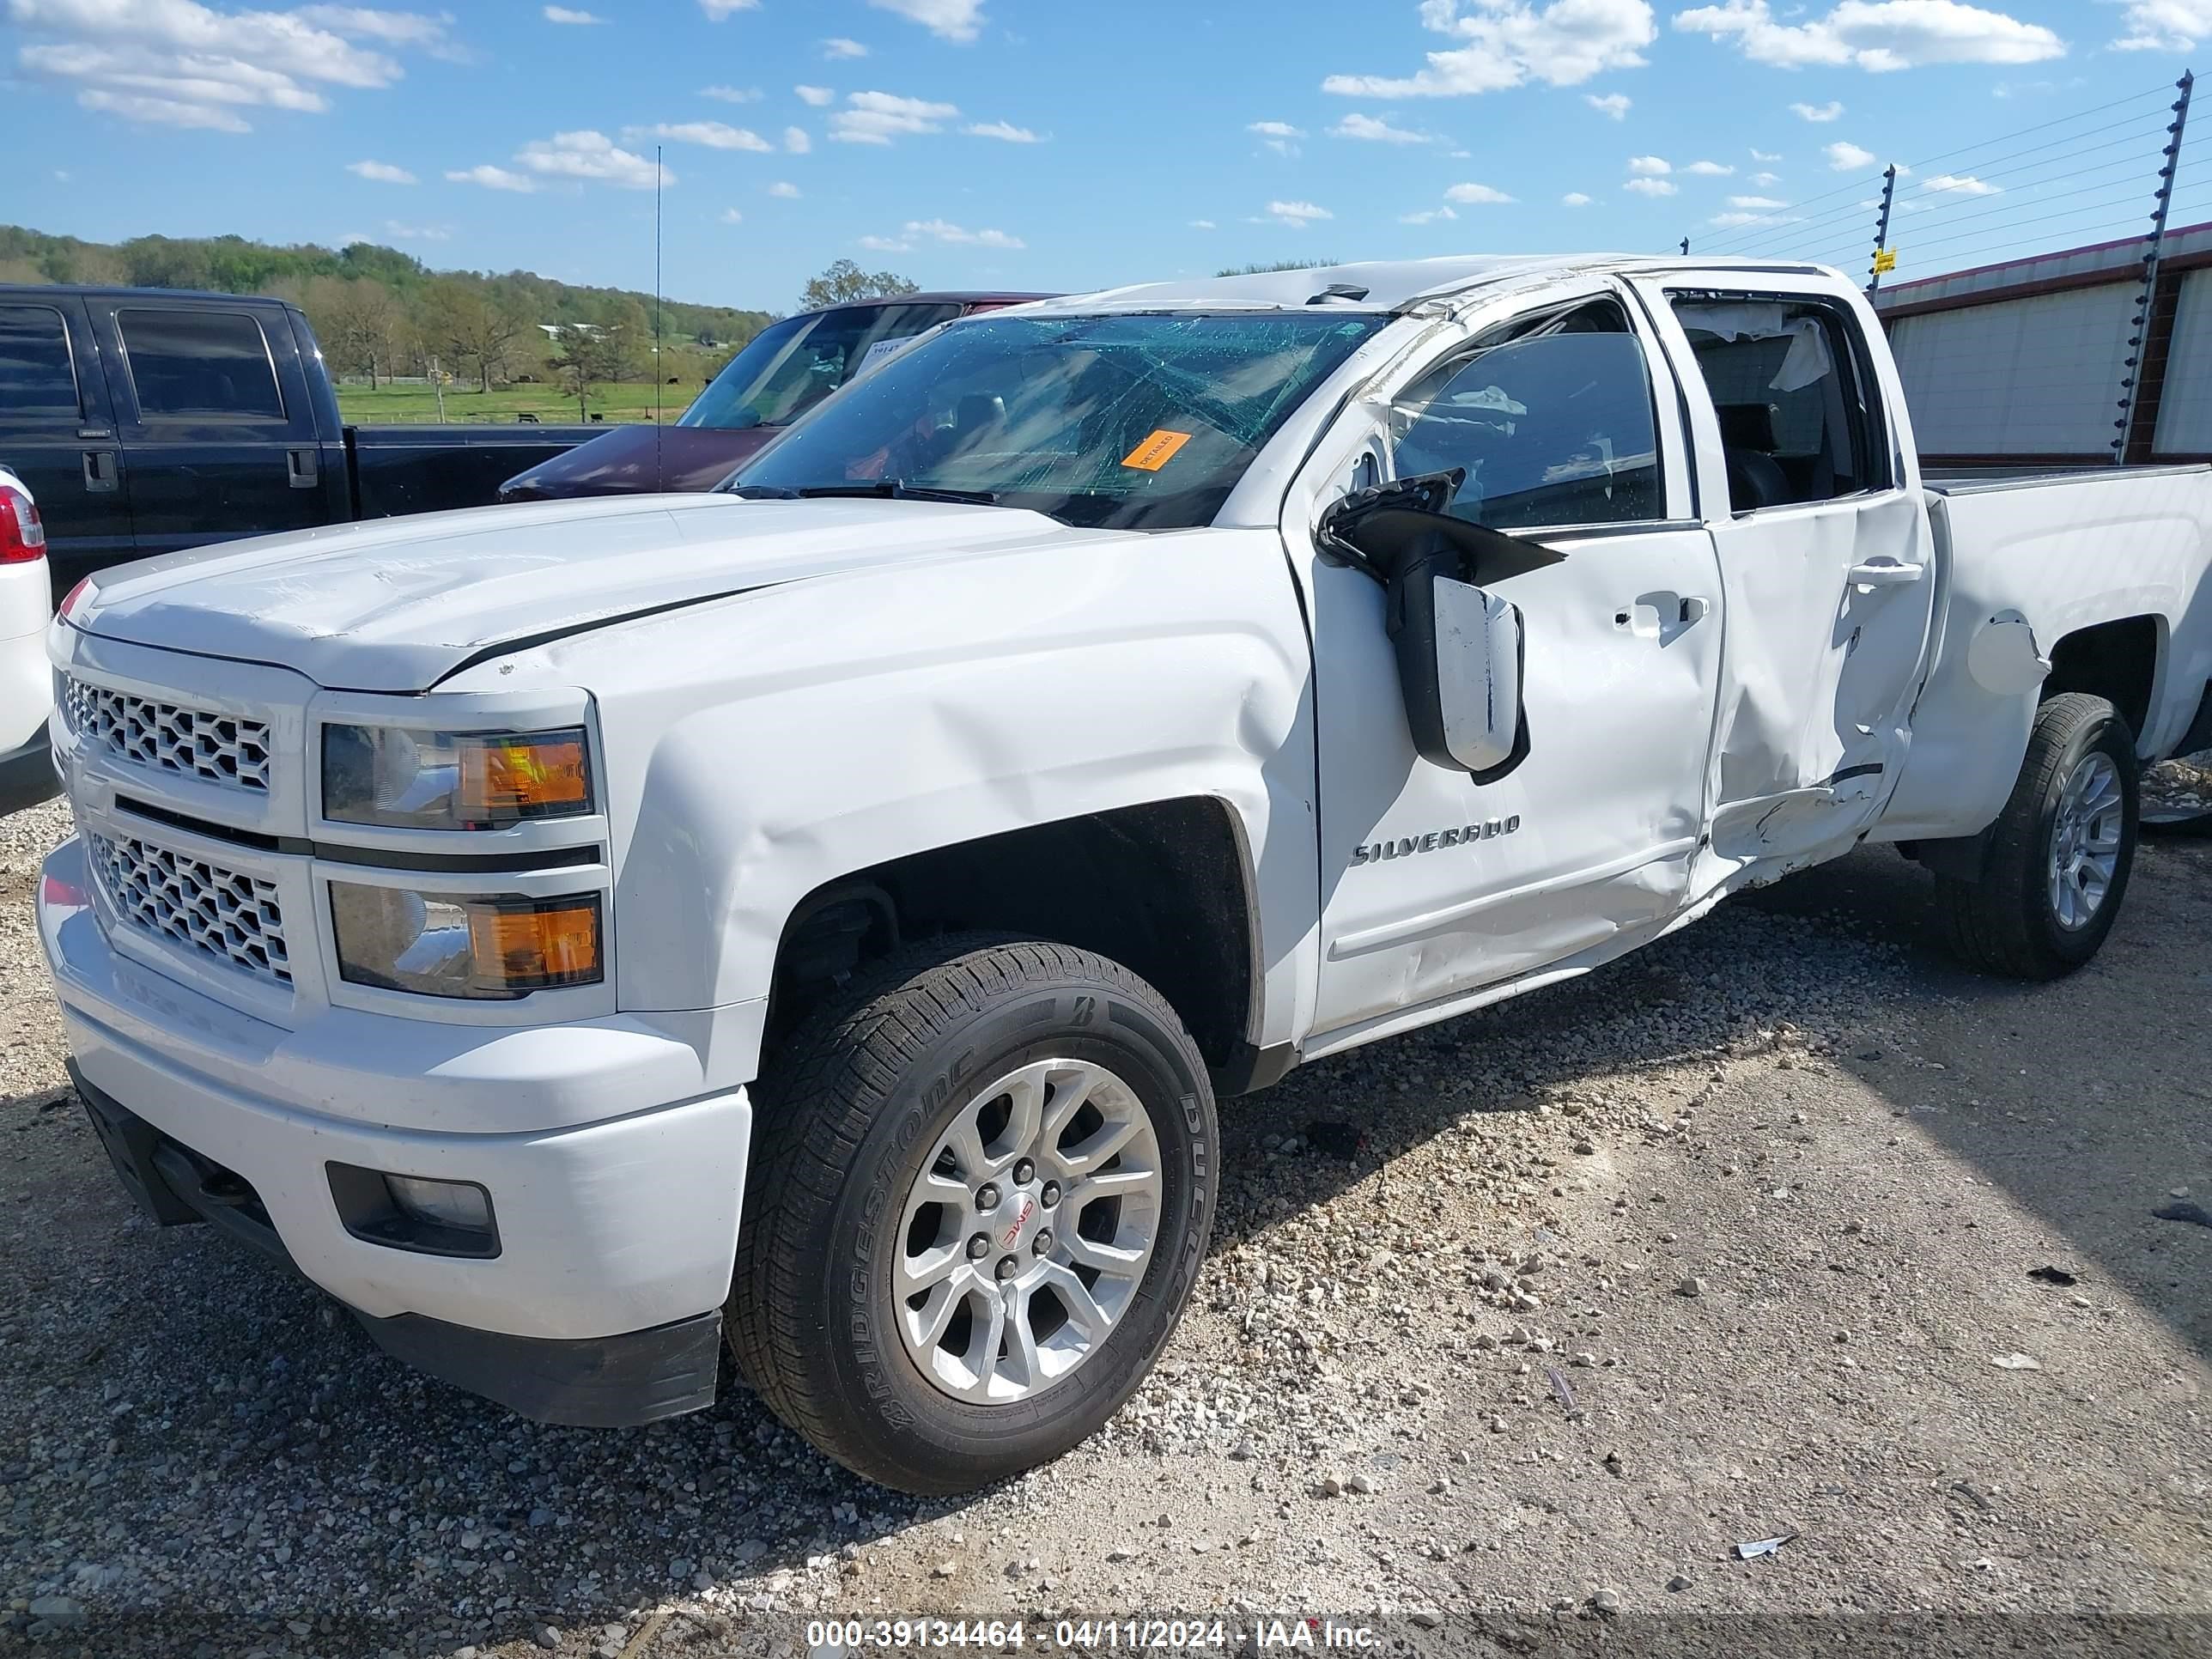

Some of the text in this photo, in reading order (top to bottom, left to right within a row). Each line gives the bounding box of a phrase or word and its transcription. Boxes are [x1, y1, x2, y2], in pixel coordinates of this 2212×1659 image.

[1140, 435, 1174, 465] DETAILED
[1348, 814, 1521, 867] SILVERADO
[1003, 1200, 1034, 1245] GMC
